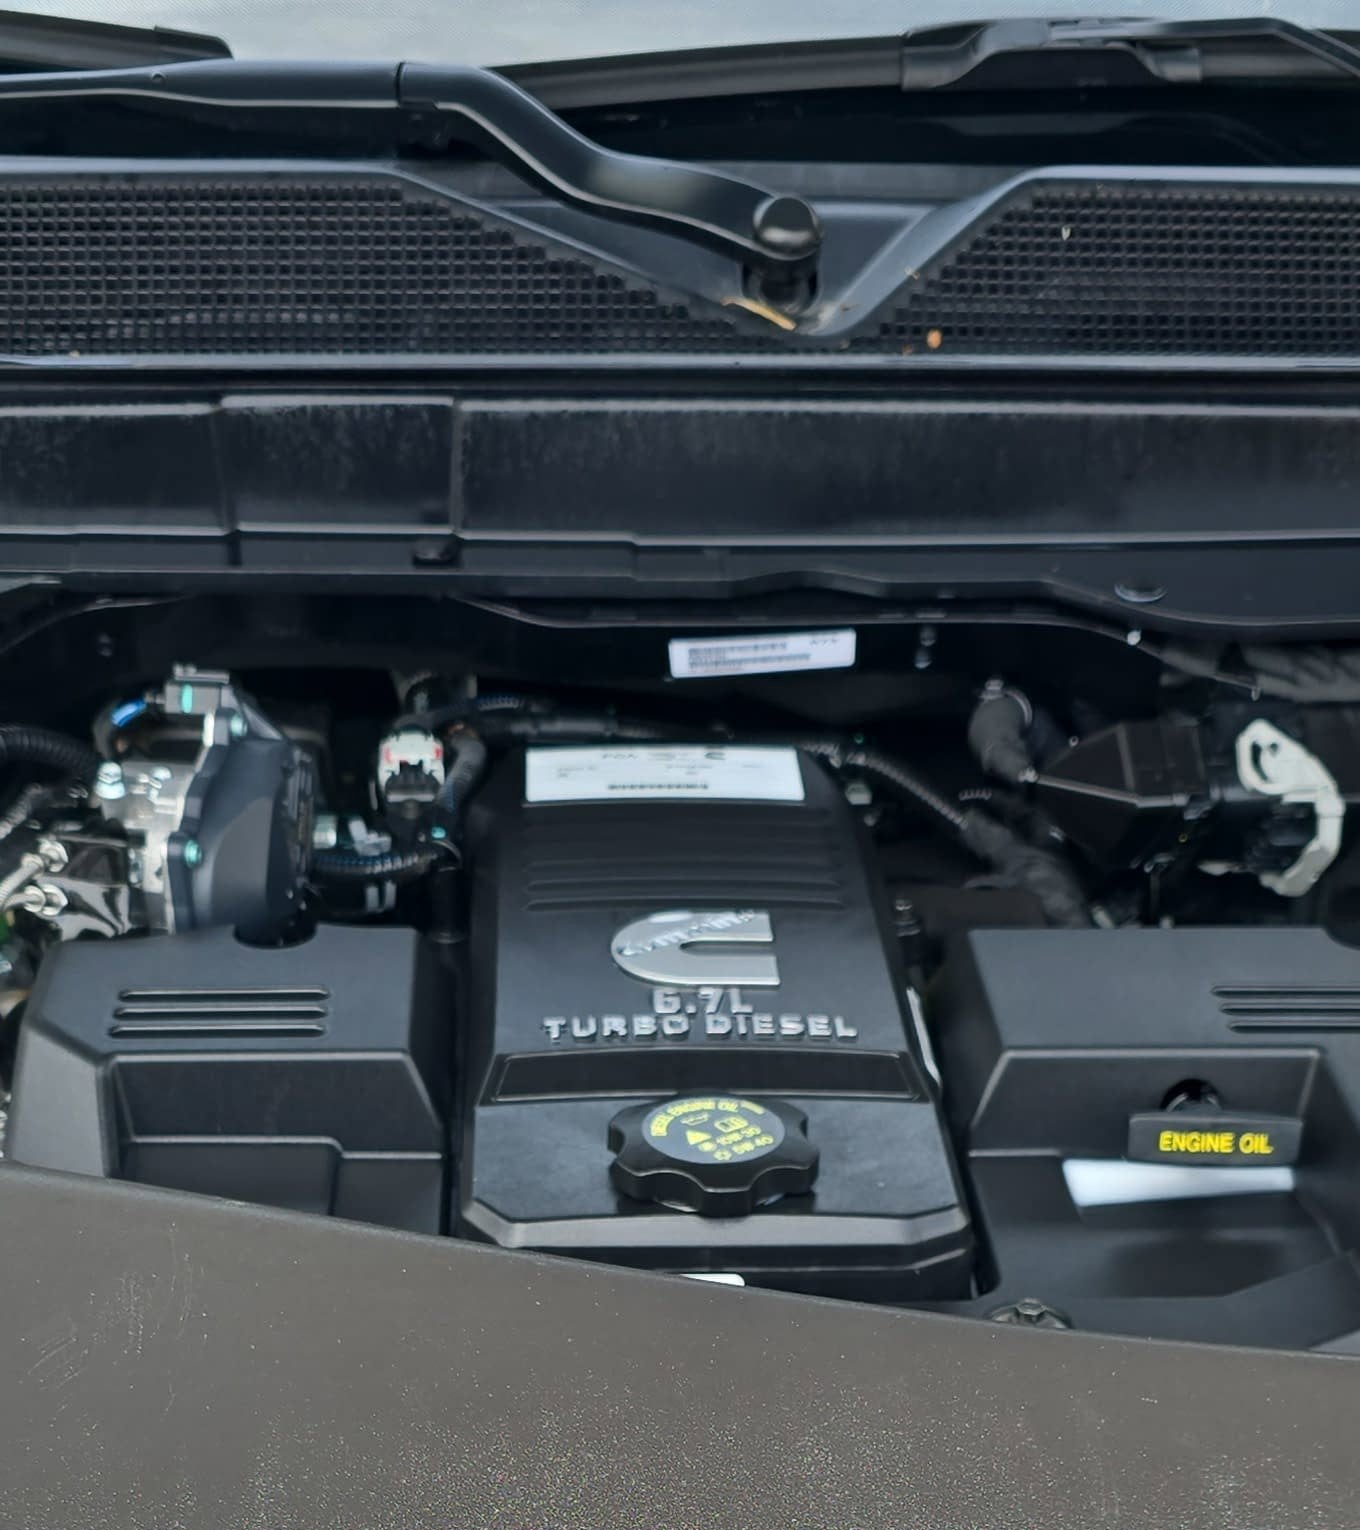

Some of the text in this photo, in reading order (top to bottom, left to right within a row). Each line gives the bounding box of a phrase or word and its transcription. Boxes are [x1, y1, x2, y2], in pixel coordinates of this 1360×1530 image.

[652, 986, 754, 1015] 6.7L
[542, 1013, 858, 1040] TURBO DIESEL
[1158, 1130, 1274, 1154] ENGINE OIL
